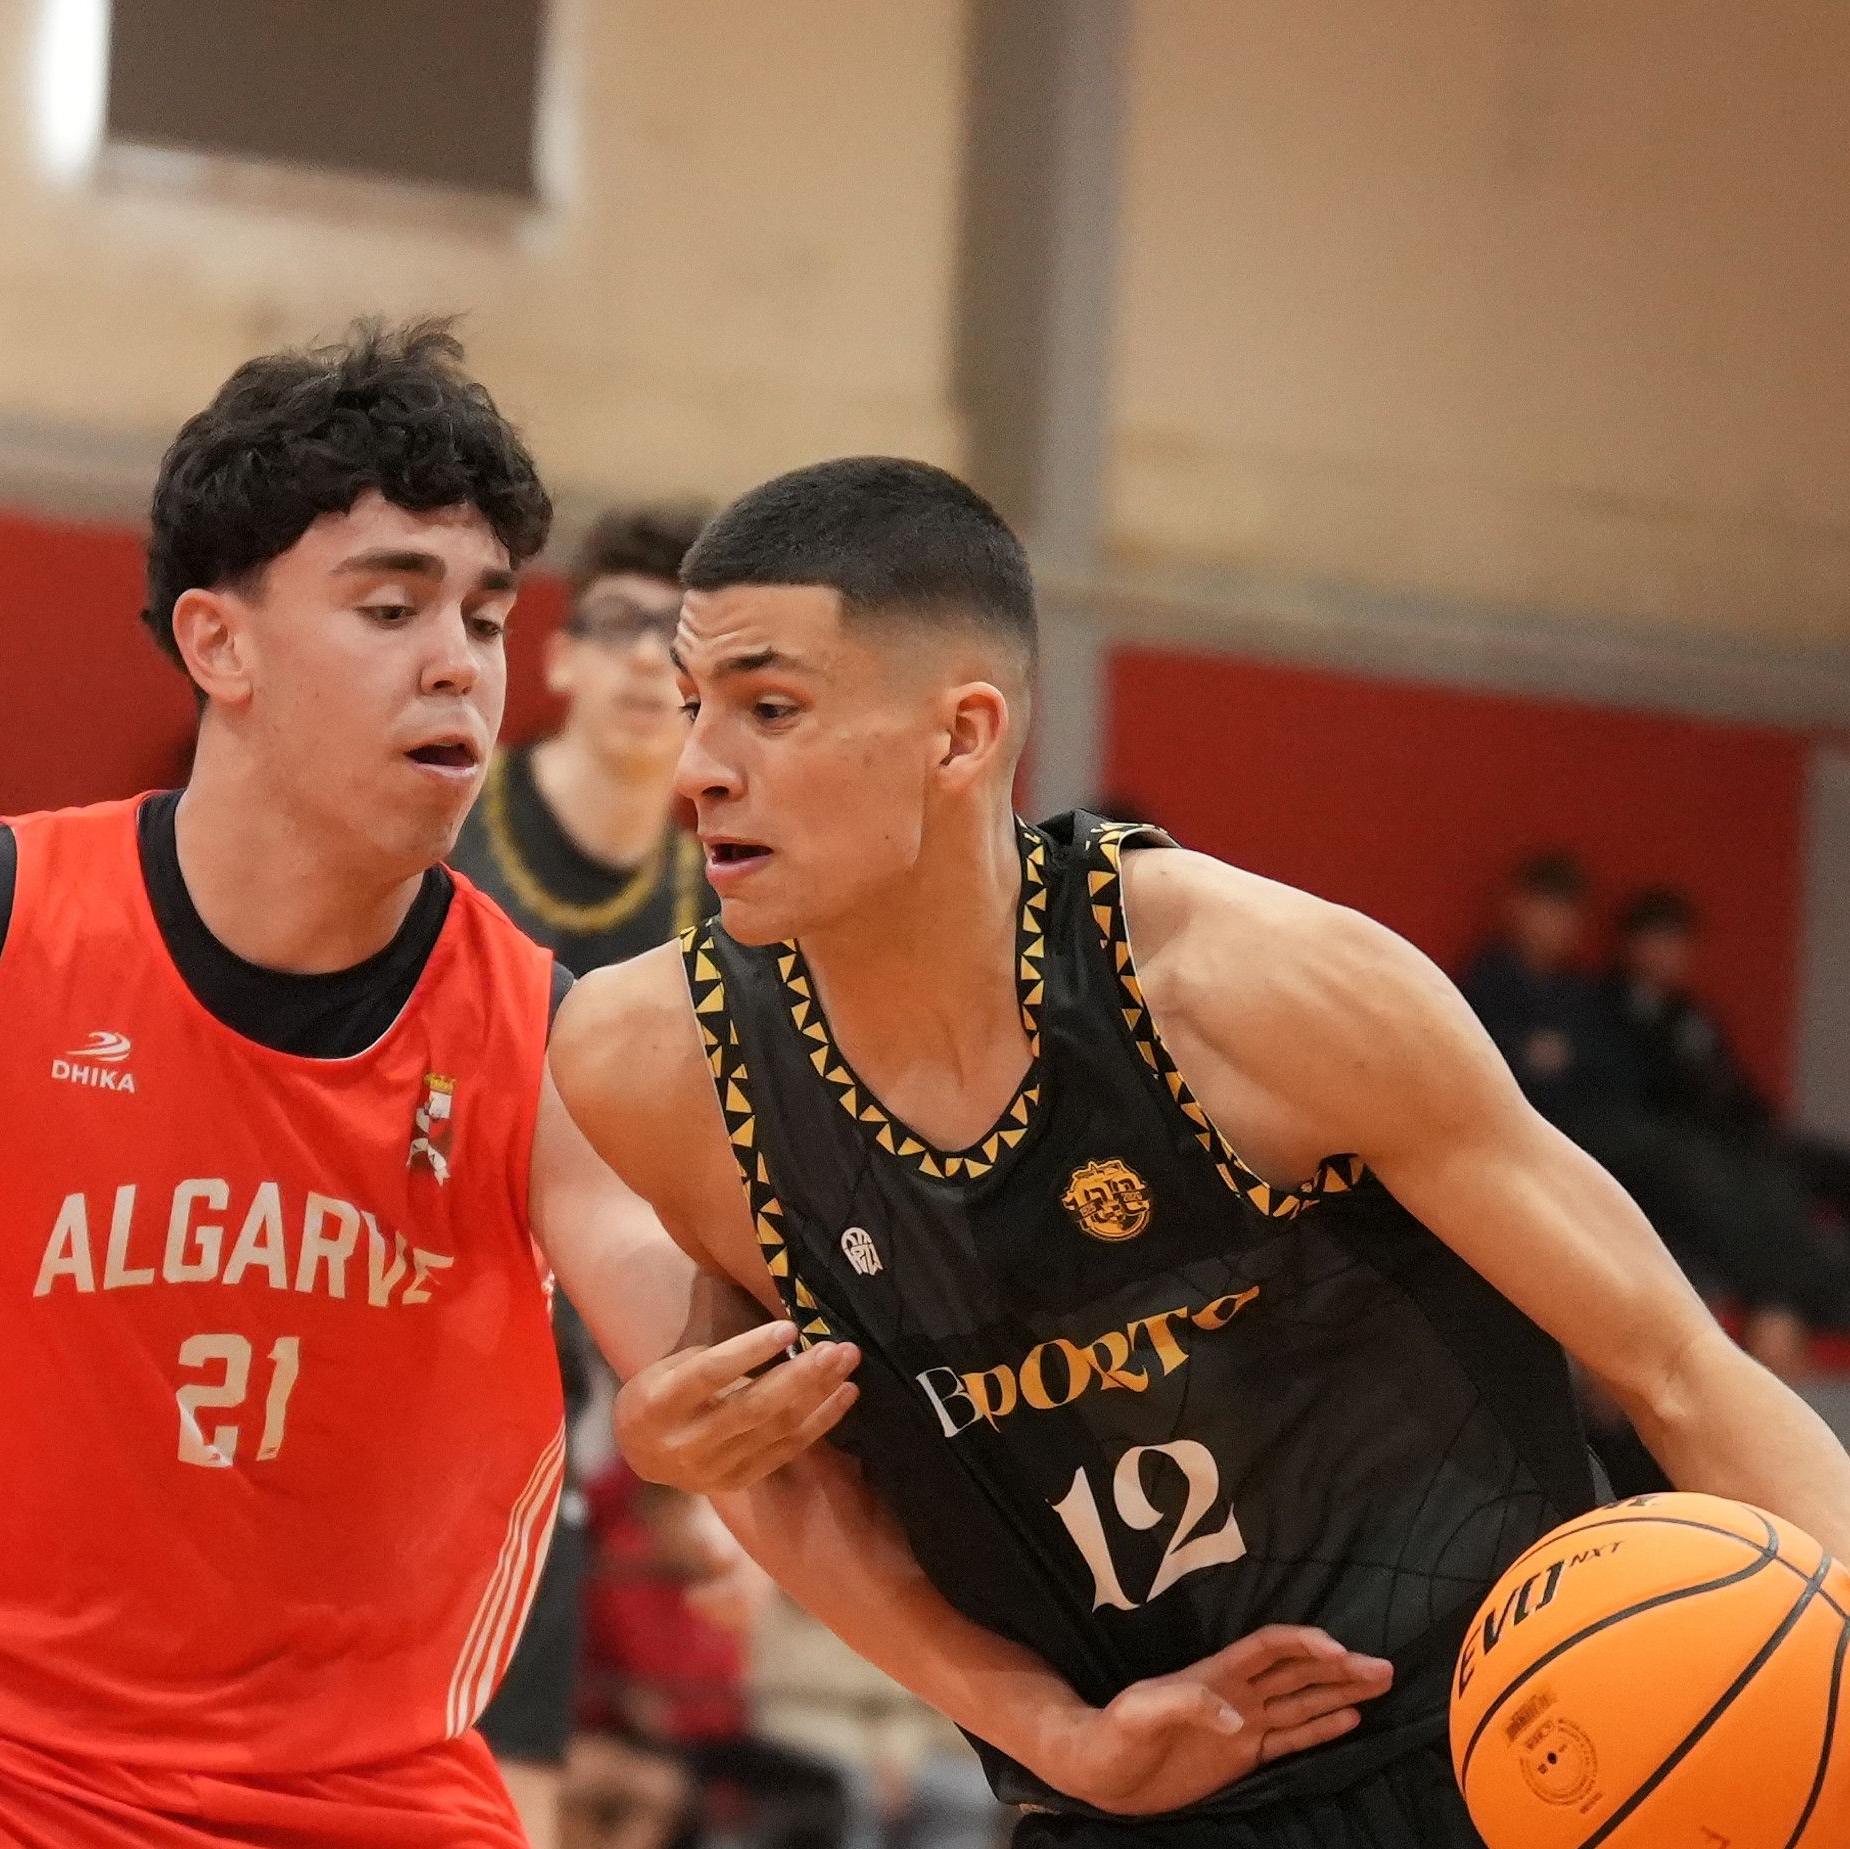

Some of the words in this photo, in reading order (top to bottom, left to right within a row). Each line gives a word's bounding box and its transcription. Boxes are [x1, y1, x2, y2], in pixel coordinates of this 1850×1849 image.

[51, 1059, 135, 1093] DHIKA
[33, 1178, 453, 1307] ALGARVE
[176, 1333, 300, 1467] 21
[1047, 1440, 1247, 1613] 12
[1459, 1560, 1565, 1700] EVO
[1569, 1541, 1624, 1567] NXT
